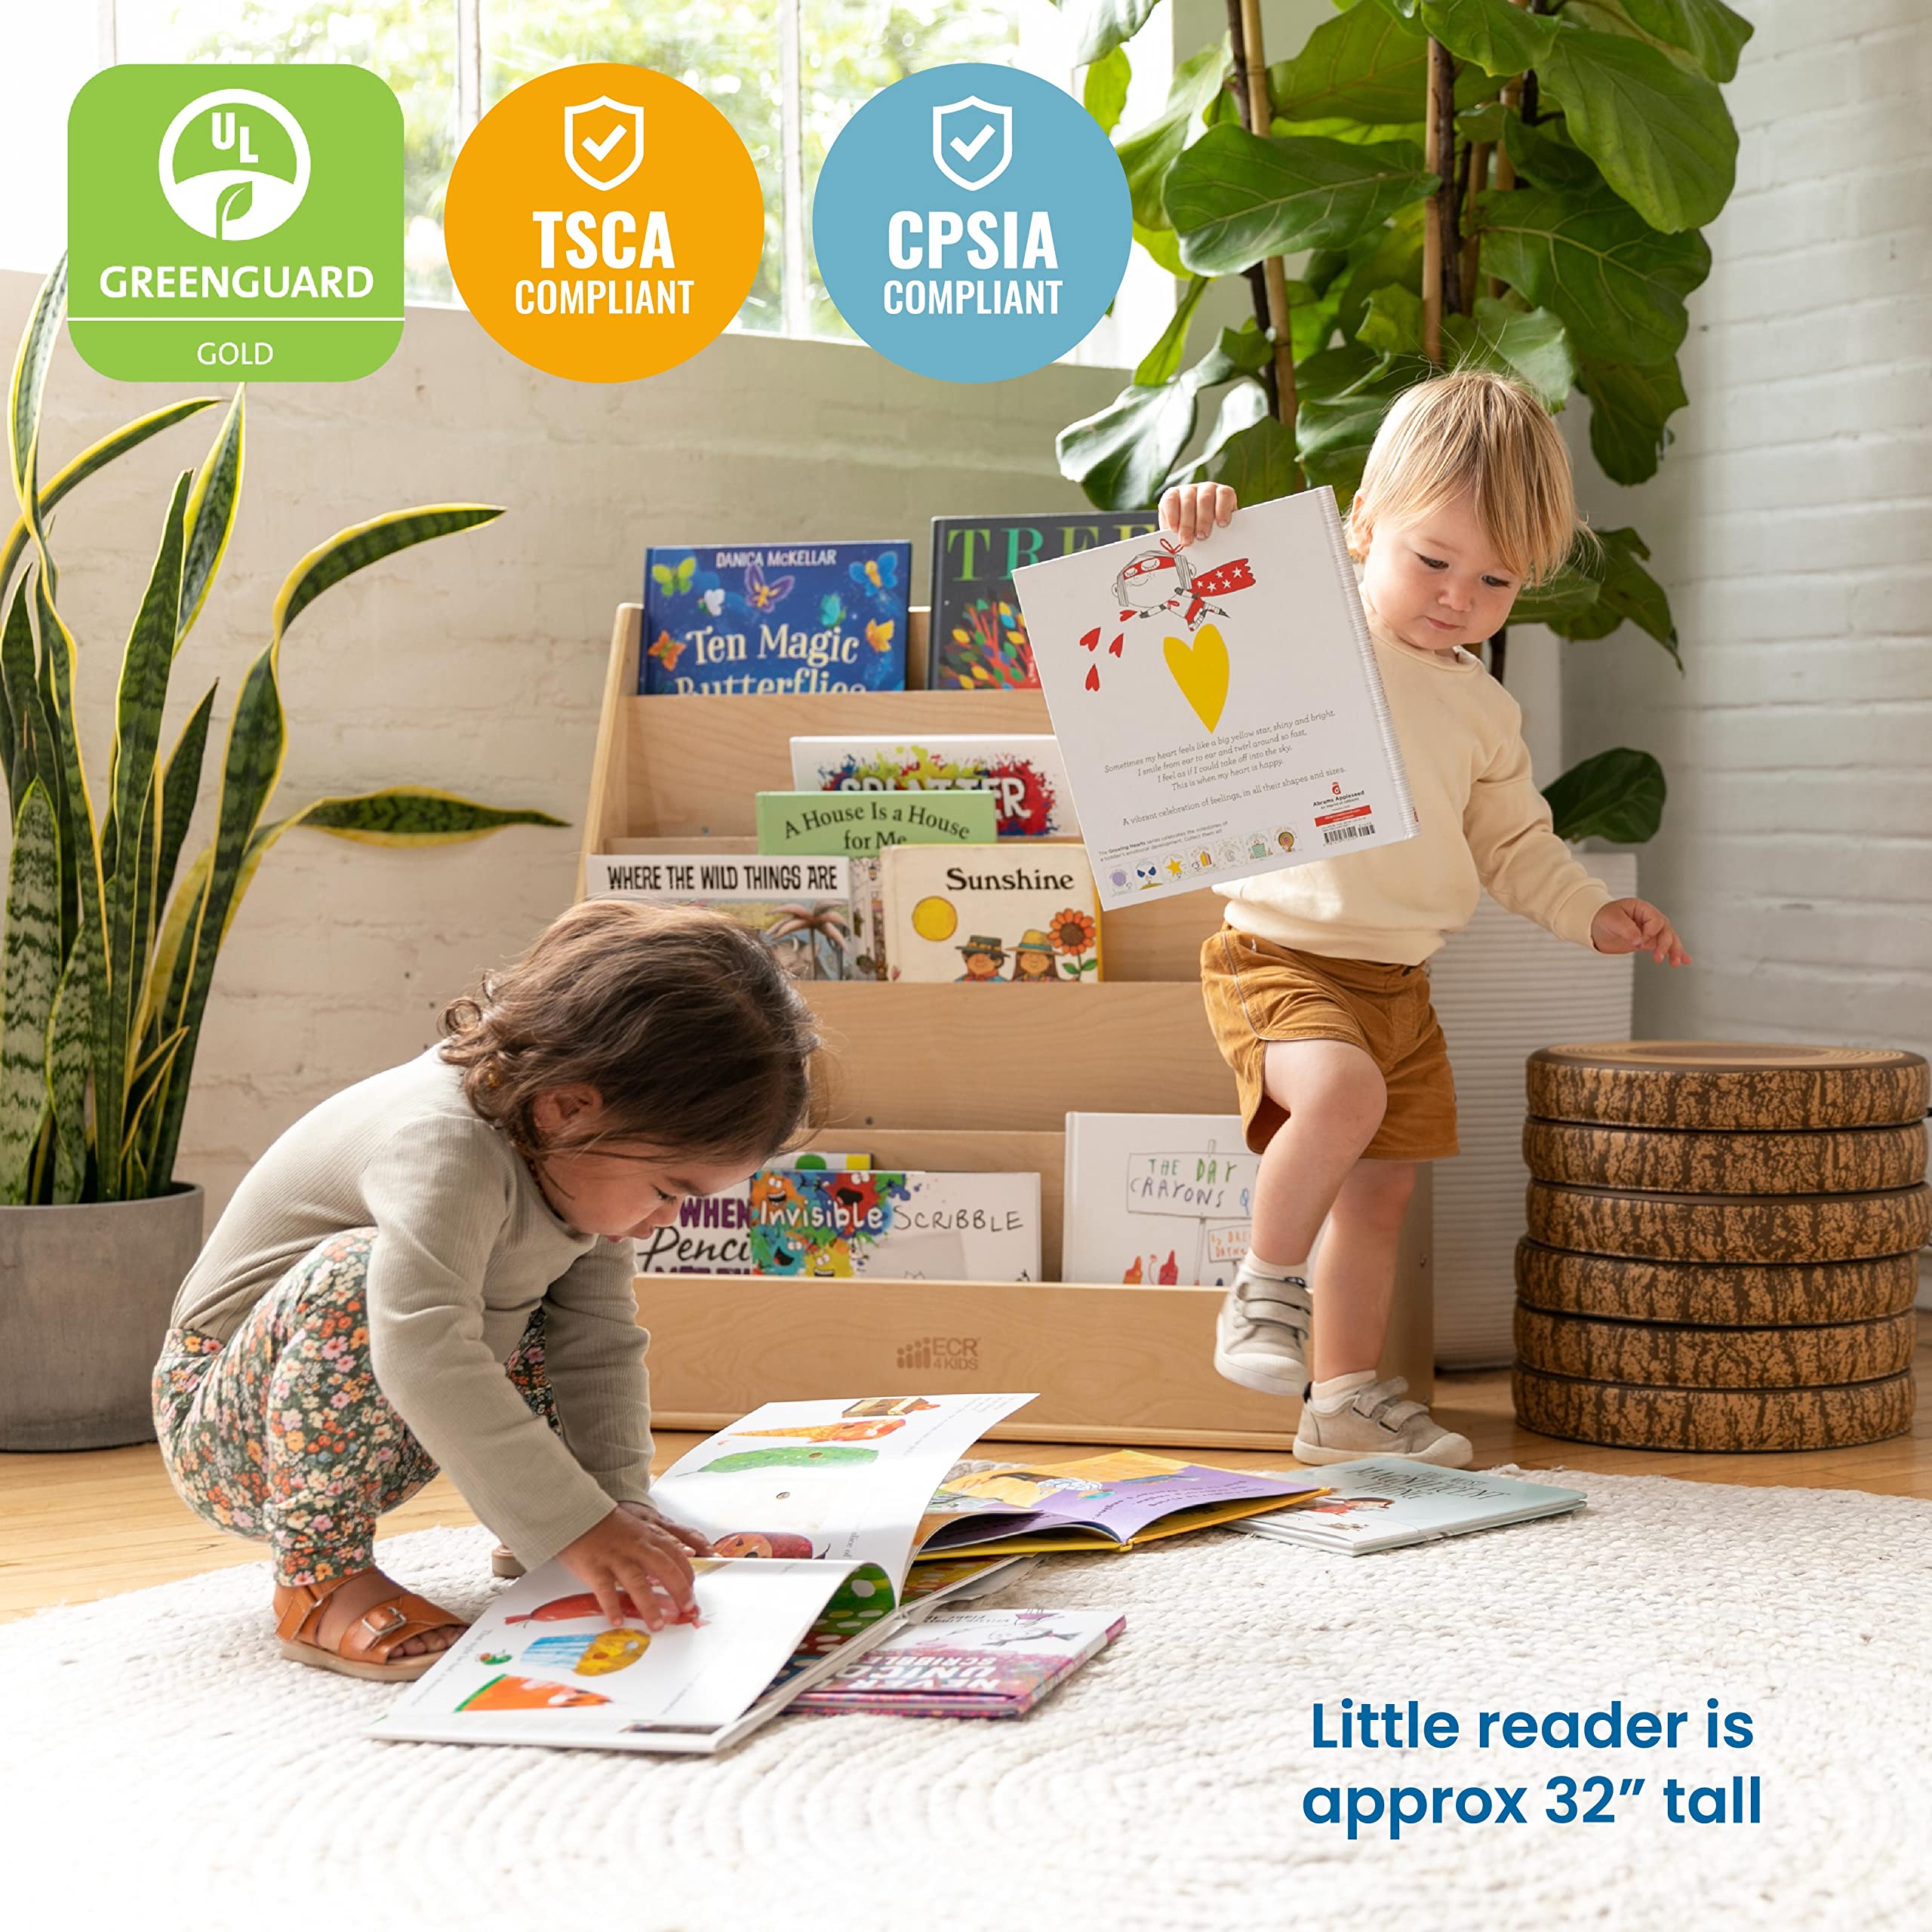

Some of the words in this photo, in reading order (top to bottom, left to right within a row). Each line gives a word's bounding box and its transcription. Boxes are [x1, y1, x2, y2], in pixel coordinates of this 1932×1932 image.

[716, 552, 764, 568] DANICA
[767, 549, 836, 567] McKELLAR
[686, 626, 746, 665] Ten
[758, 624, 860, 668] Magic
[1105, 758, 1143, 773] Sometimes
[1146, 754, 1155, 764] my
[1158, 749, 1177, 760] heart
[1179, 744, 1195, 754] feels
[1197, 740, 1210, 750] like
[1218, 737, 1229, 746] big
[1231, 731, 1254, 743] yellow
[1256, 726, 1272, 735] star,
[1273, 721, 1293, 732] shiny
[1295, 715, 1309, 725] and
[1311, 710, 1335, 721] bright.
[1143, 763, 1161, 775] smile
[1163, 761, 1180, 771] from
[1182, 757, 1194, 765] ear
[1219, 746, 1232, 756] and
[1235, 741, 1251, 752] twirl
[1253, 734, 1279, 747] around
[1291, 730, 1306, 739] fast,
[1163, 772, 1176, 782] feel
[1187, 766, 1194, 776] if
[1194, 766, 1198, 774] I
[1199, 761, 1219, 773] could
[1220, 757, 1236, 768] take
[1238, 753, 1247, 763] off
[1250, 751, 1263, 760] into
[1265, 748, 1277, 756] the
[1278, 744, 1292, 753] sky.
[1171, 781, 1188, 791] This
[1196, 775, 1217, 786] when
[1217, 772, 1229, 780] my
[1230, 766, 1250, 777] heart
[1260, 758, 1284, 769] happy.
[1122, 817, 1129, 826] A
[1131, 812, 1158, 823] vibrant
[1158, 801, 1200, 817] celebration
[1201, 798, 1209, 807] of
[1210, 789, 1242, 804] feelings,
[1243, 789, 1251, 797] in
[1252, 785, 1261, 794] all
[1263, 781, 1281, 792] their
[1282, 774, 1309, 788] shapes
[1309, 771, 1324, 780] and
[1326, 766, 1346, 777] sizes.
[1313, 798, 1334, 807] Abrams
[1336, 790, 1365, 803] Appleseed
[784, 820, 800, 838] A
[801, 803, 865, 829] House
[870, 801, 887, 820] Is
[892, 808, 903, 821] a
[908, 804, 971, 840] House
[844, 830, 870, 851] for
[875, 831, 906, 849] Me
[608, 866, 661, 891] WHERE
[666, 865, 694, 890] THE
[701, 866, 738, 890] WILD
[743, 865, 801, 890] THINGS
[807, 866, 838, 890] ARE
[946, 867, 1075, 891] Sunshine
[1148, 1158, 1181, 1176] THE
[1195, 1158, 1238, 1184] DAY
[1131, 1176, 1225, 1208] CRAYONS
[761, 1199, 884, 1229] Invisible
[893, 1205, 1024, 1232] SCRIBBLE
[637, 1226, 751, 1272] Penci
[933, 1337, 978, 1356] ECR
[1346, 1466, 1512, 1500] MAGNIFICENT
[835, 1664, 997, 1679] UNICO
[848, 1678, 1001, 1690] NEVER
